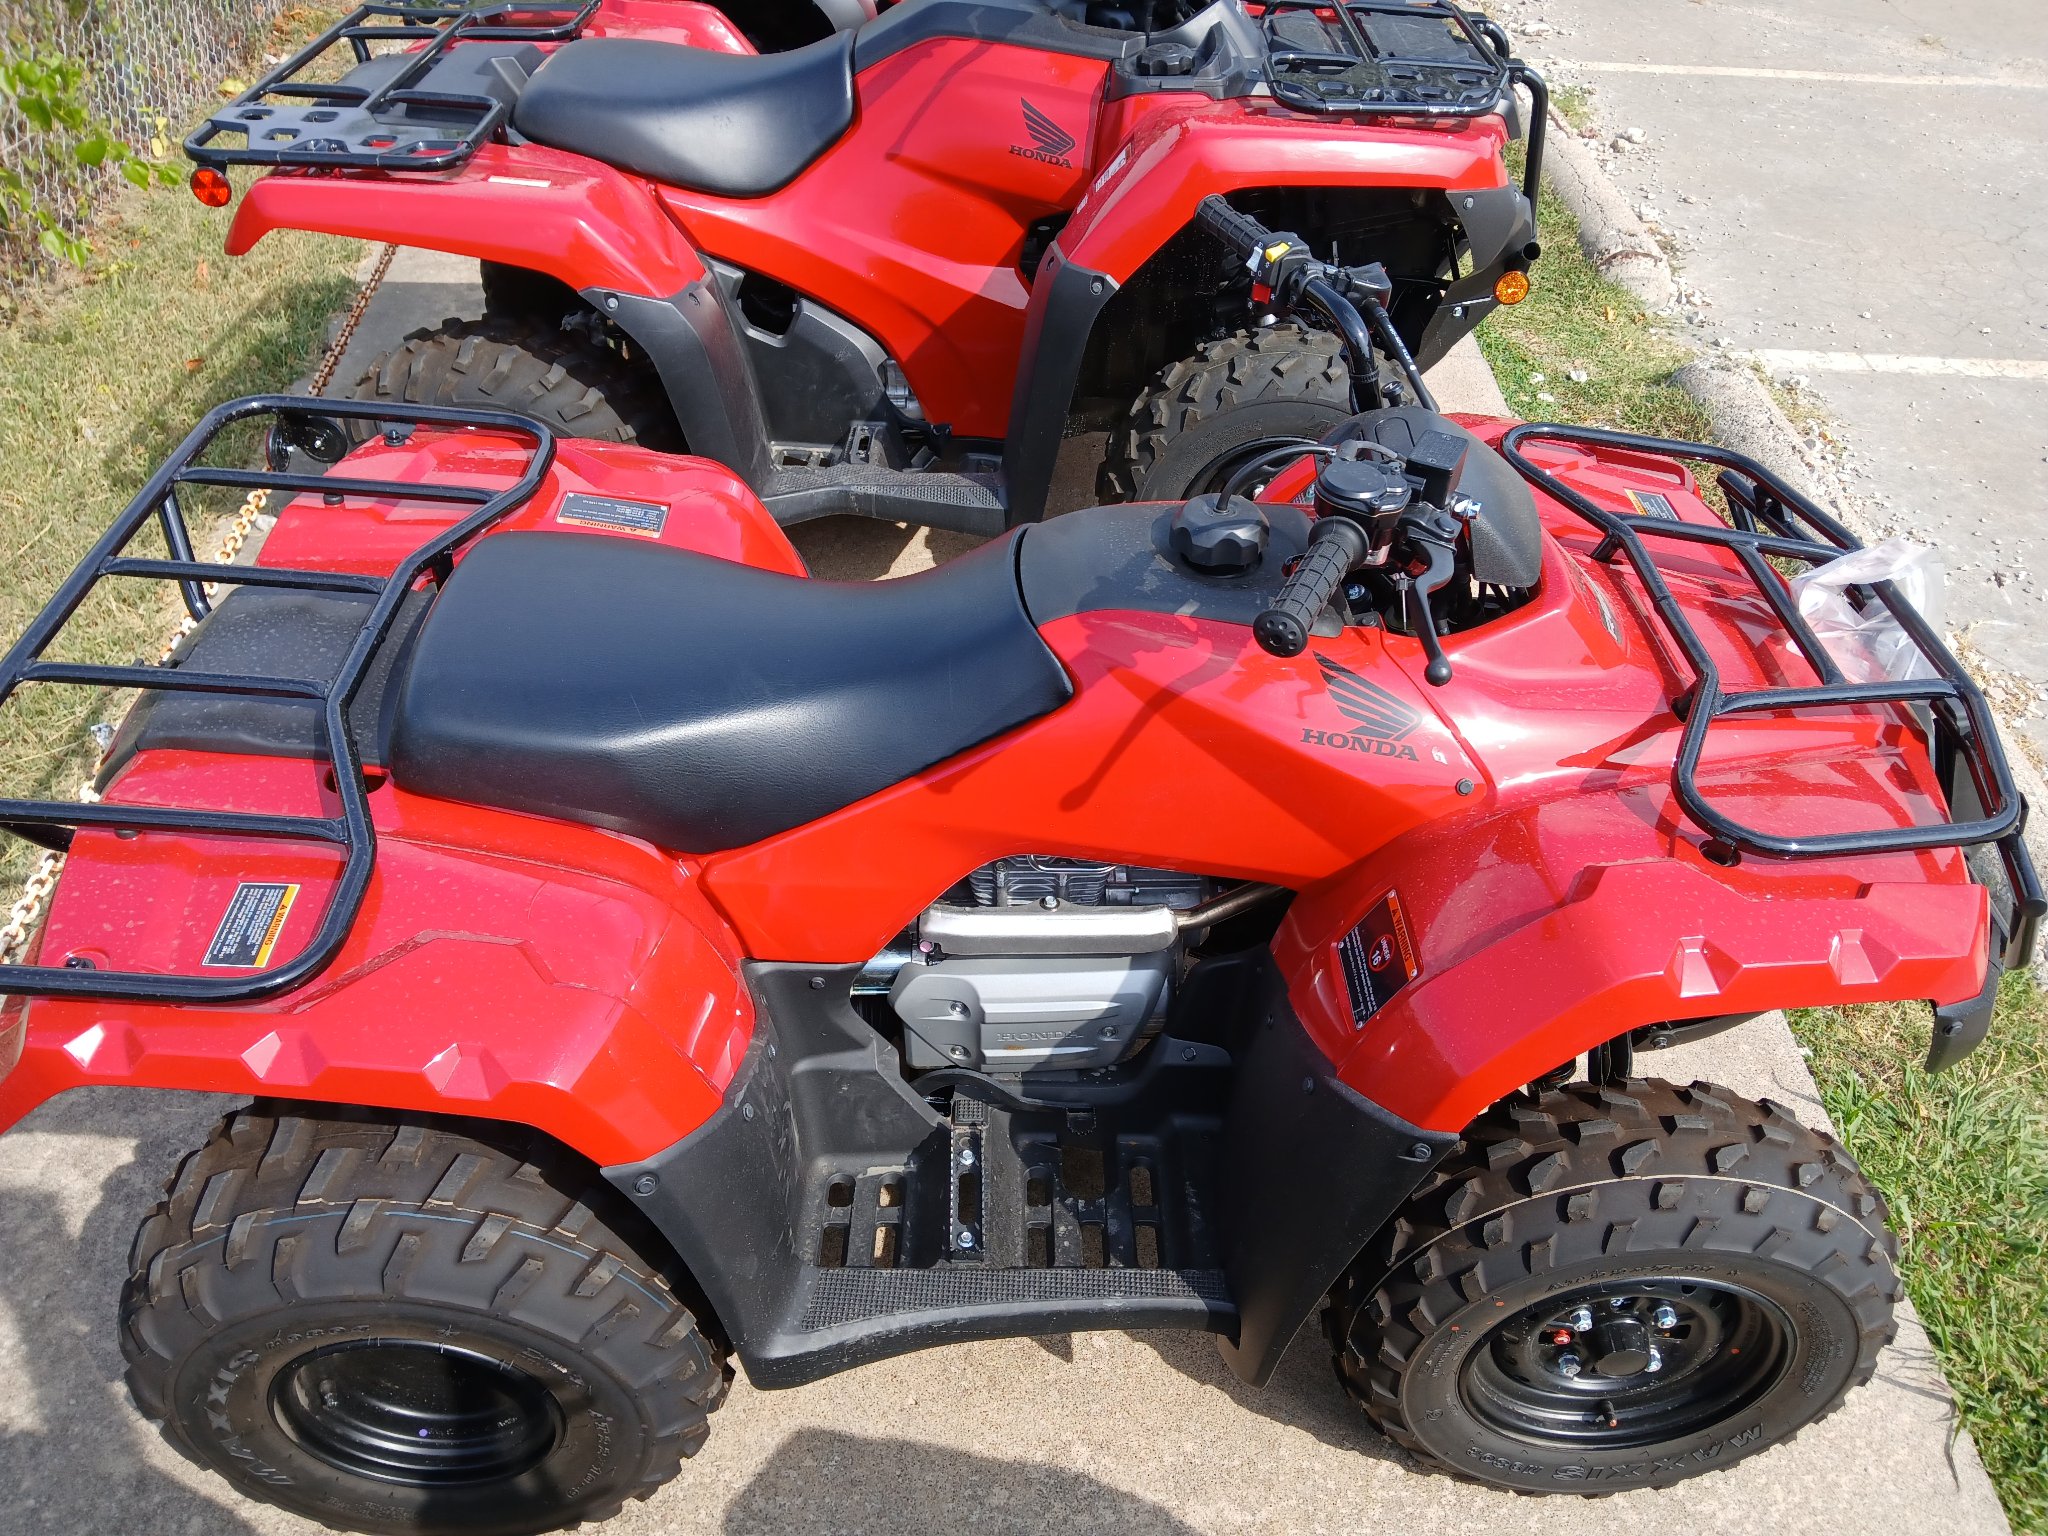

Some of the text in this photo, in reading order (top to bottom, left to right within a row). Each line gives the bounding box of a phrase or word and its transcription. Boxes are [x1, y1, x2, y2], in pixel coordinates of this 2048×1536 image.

[1009, 145, 1072, 169] HONDA
[579, 520, 626, 531] WARNING
[1300, 728, 1419, 762] HONDA
[263, 911, 285, 945] WARNING
[1394, 916, 1411, 962] WARNING
[1370, 948, 1381, 967] 16
[1380, 936, 1390, 961] UNDER
[996, 1031, 1084, 1042] HONDA
[206, 1349, 295, 1485] MAXXIS
[1552, 1422, 1764, 1482] MAXXIS
